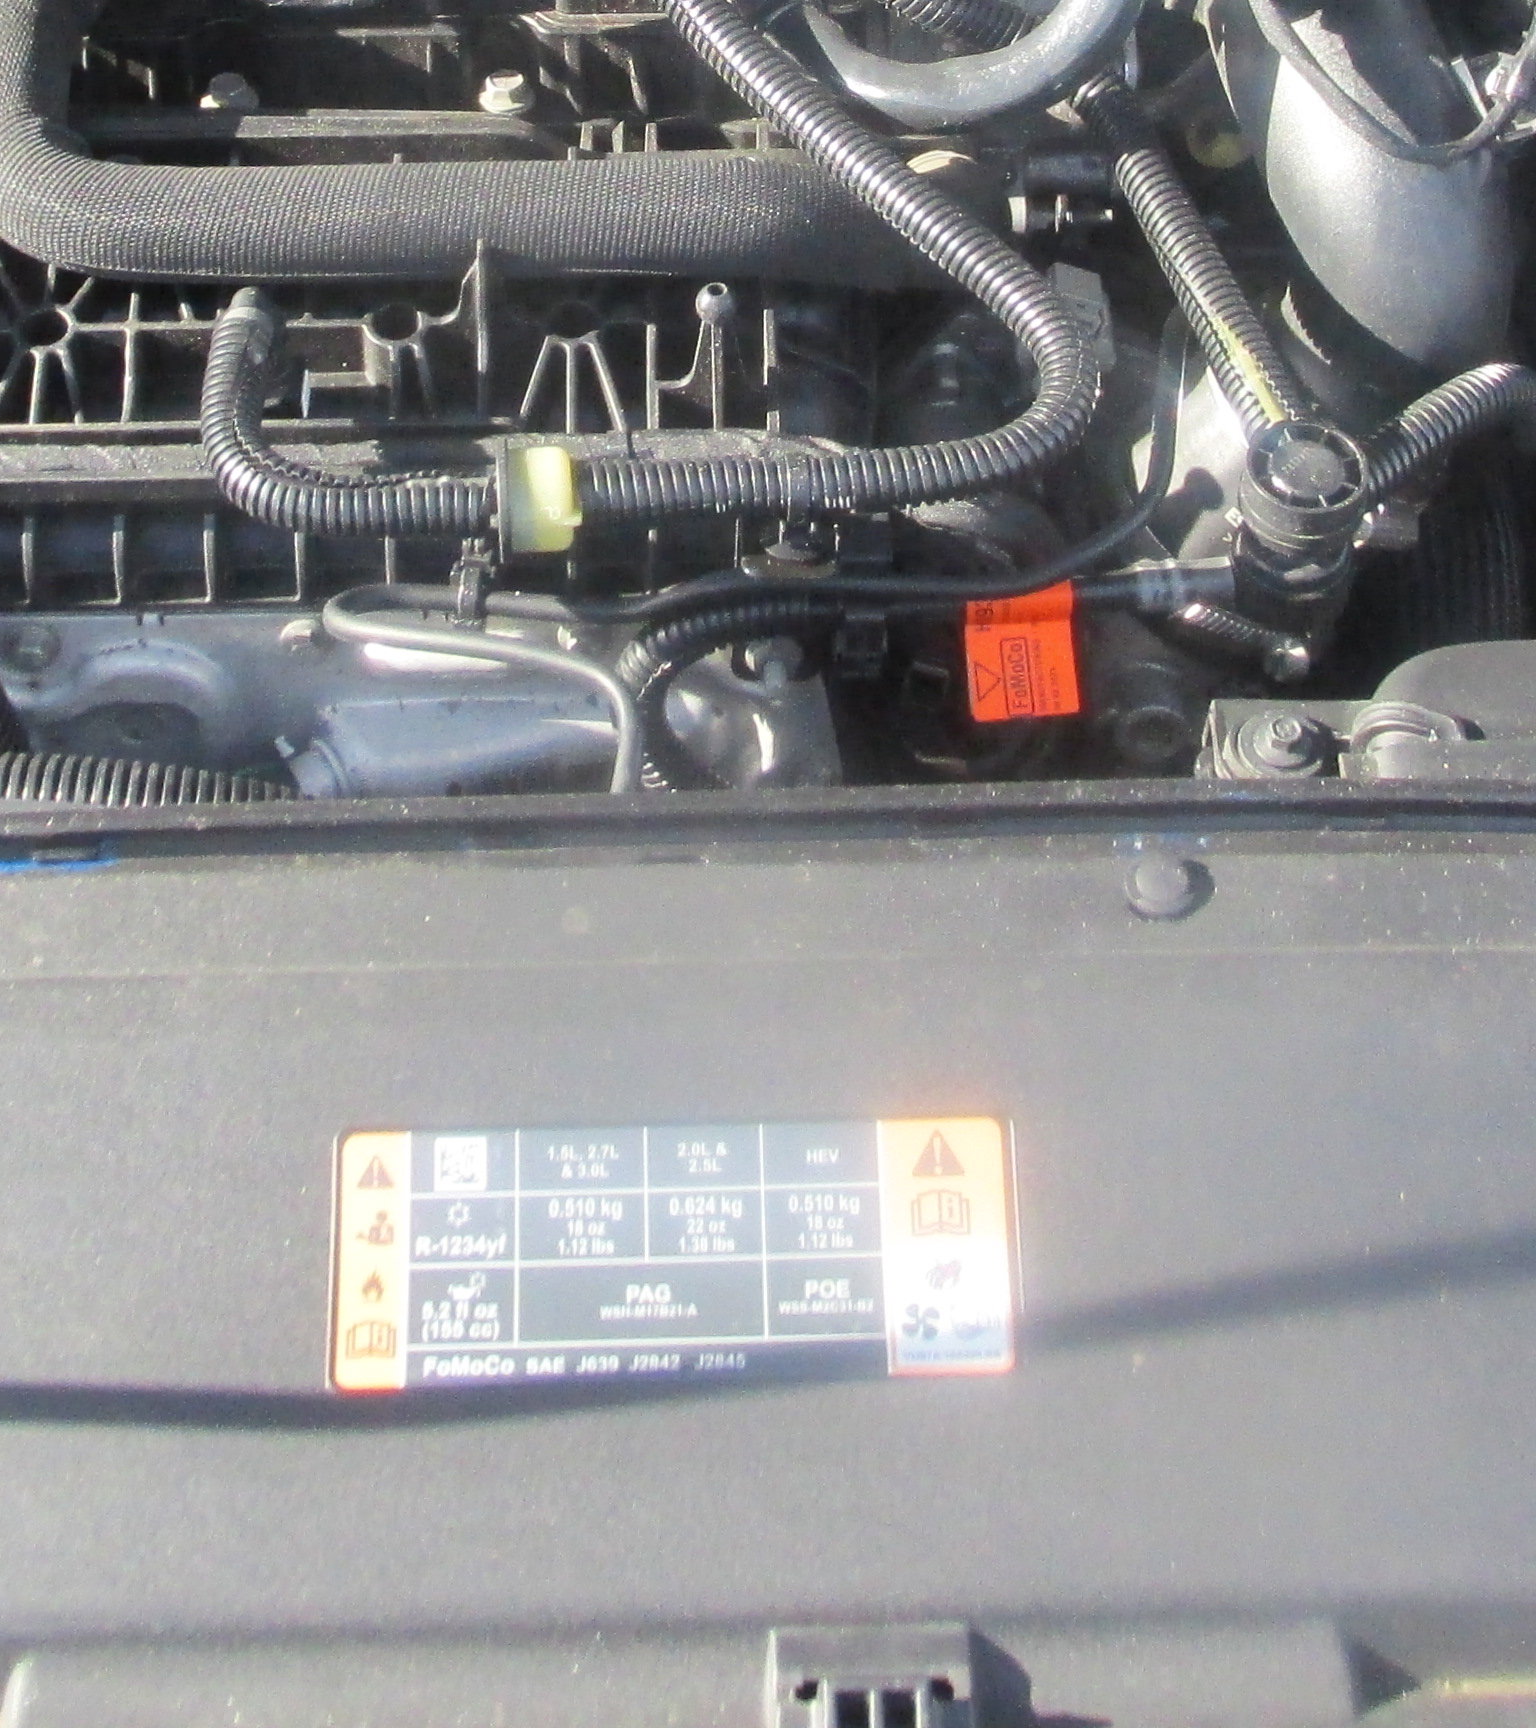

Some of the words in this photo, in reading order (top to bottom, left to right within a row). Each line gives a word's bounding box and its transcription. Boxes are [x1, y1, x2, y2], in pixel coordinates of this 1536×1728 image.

[1006, 642, 1028, 709] FoMoCo
[676, 1142, 710, 1158] 2.0L
[806, 1148, 840, 1164] HEV
[600, 1197, 623, 1221] kg
[721, 1195, 743, 1219] kg
[839, 1193, 860, 1216] kg
[588, 1222, 606, 1236] oz
[686, 1218, 704, 1234] 22
[708, 1220, 727, 1234] oz
[827, 1217, 845, 1230] oz
[415, 1233, 507, 1260] R-1234yf
[591, 1239, 615, 1255] lbs
[713, 1236, 735, 1252] lbs
[797, 1232, 828, 1249] 1.12
[831, 1232, 854, 1248] lbs
[625, 1282, 672, 1304] PAG
[804, 1278, 851, 1300] POE
[474, 1301, 499, 1319] oz
[423, 1354, 515, 1378] FoMoCo
